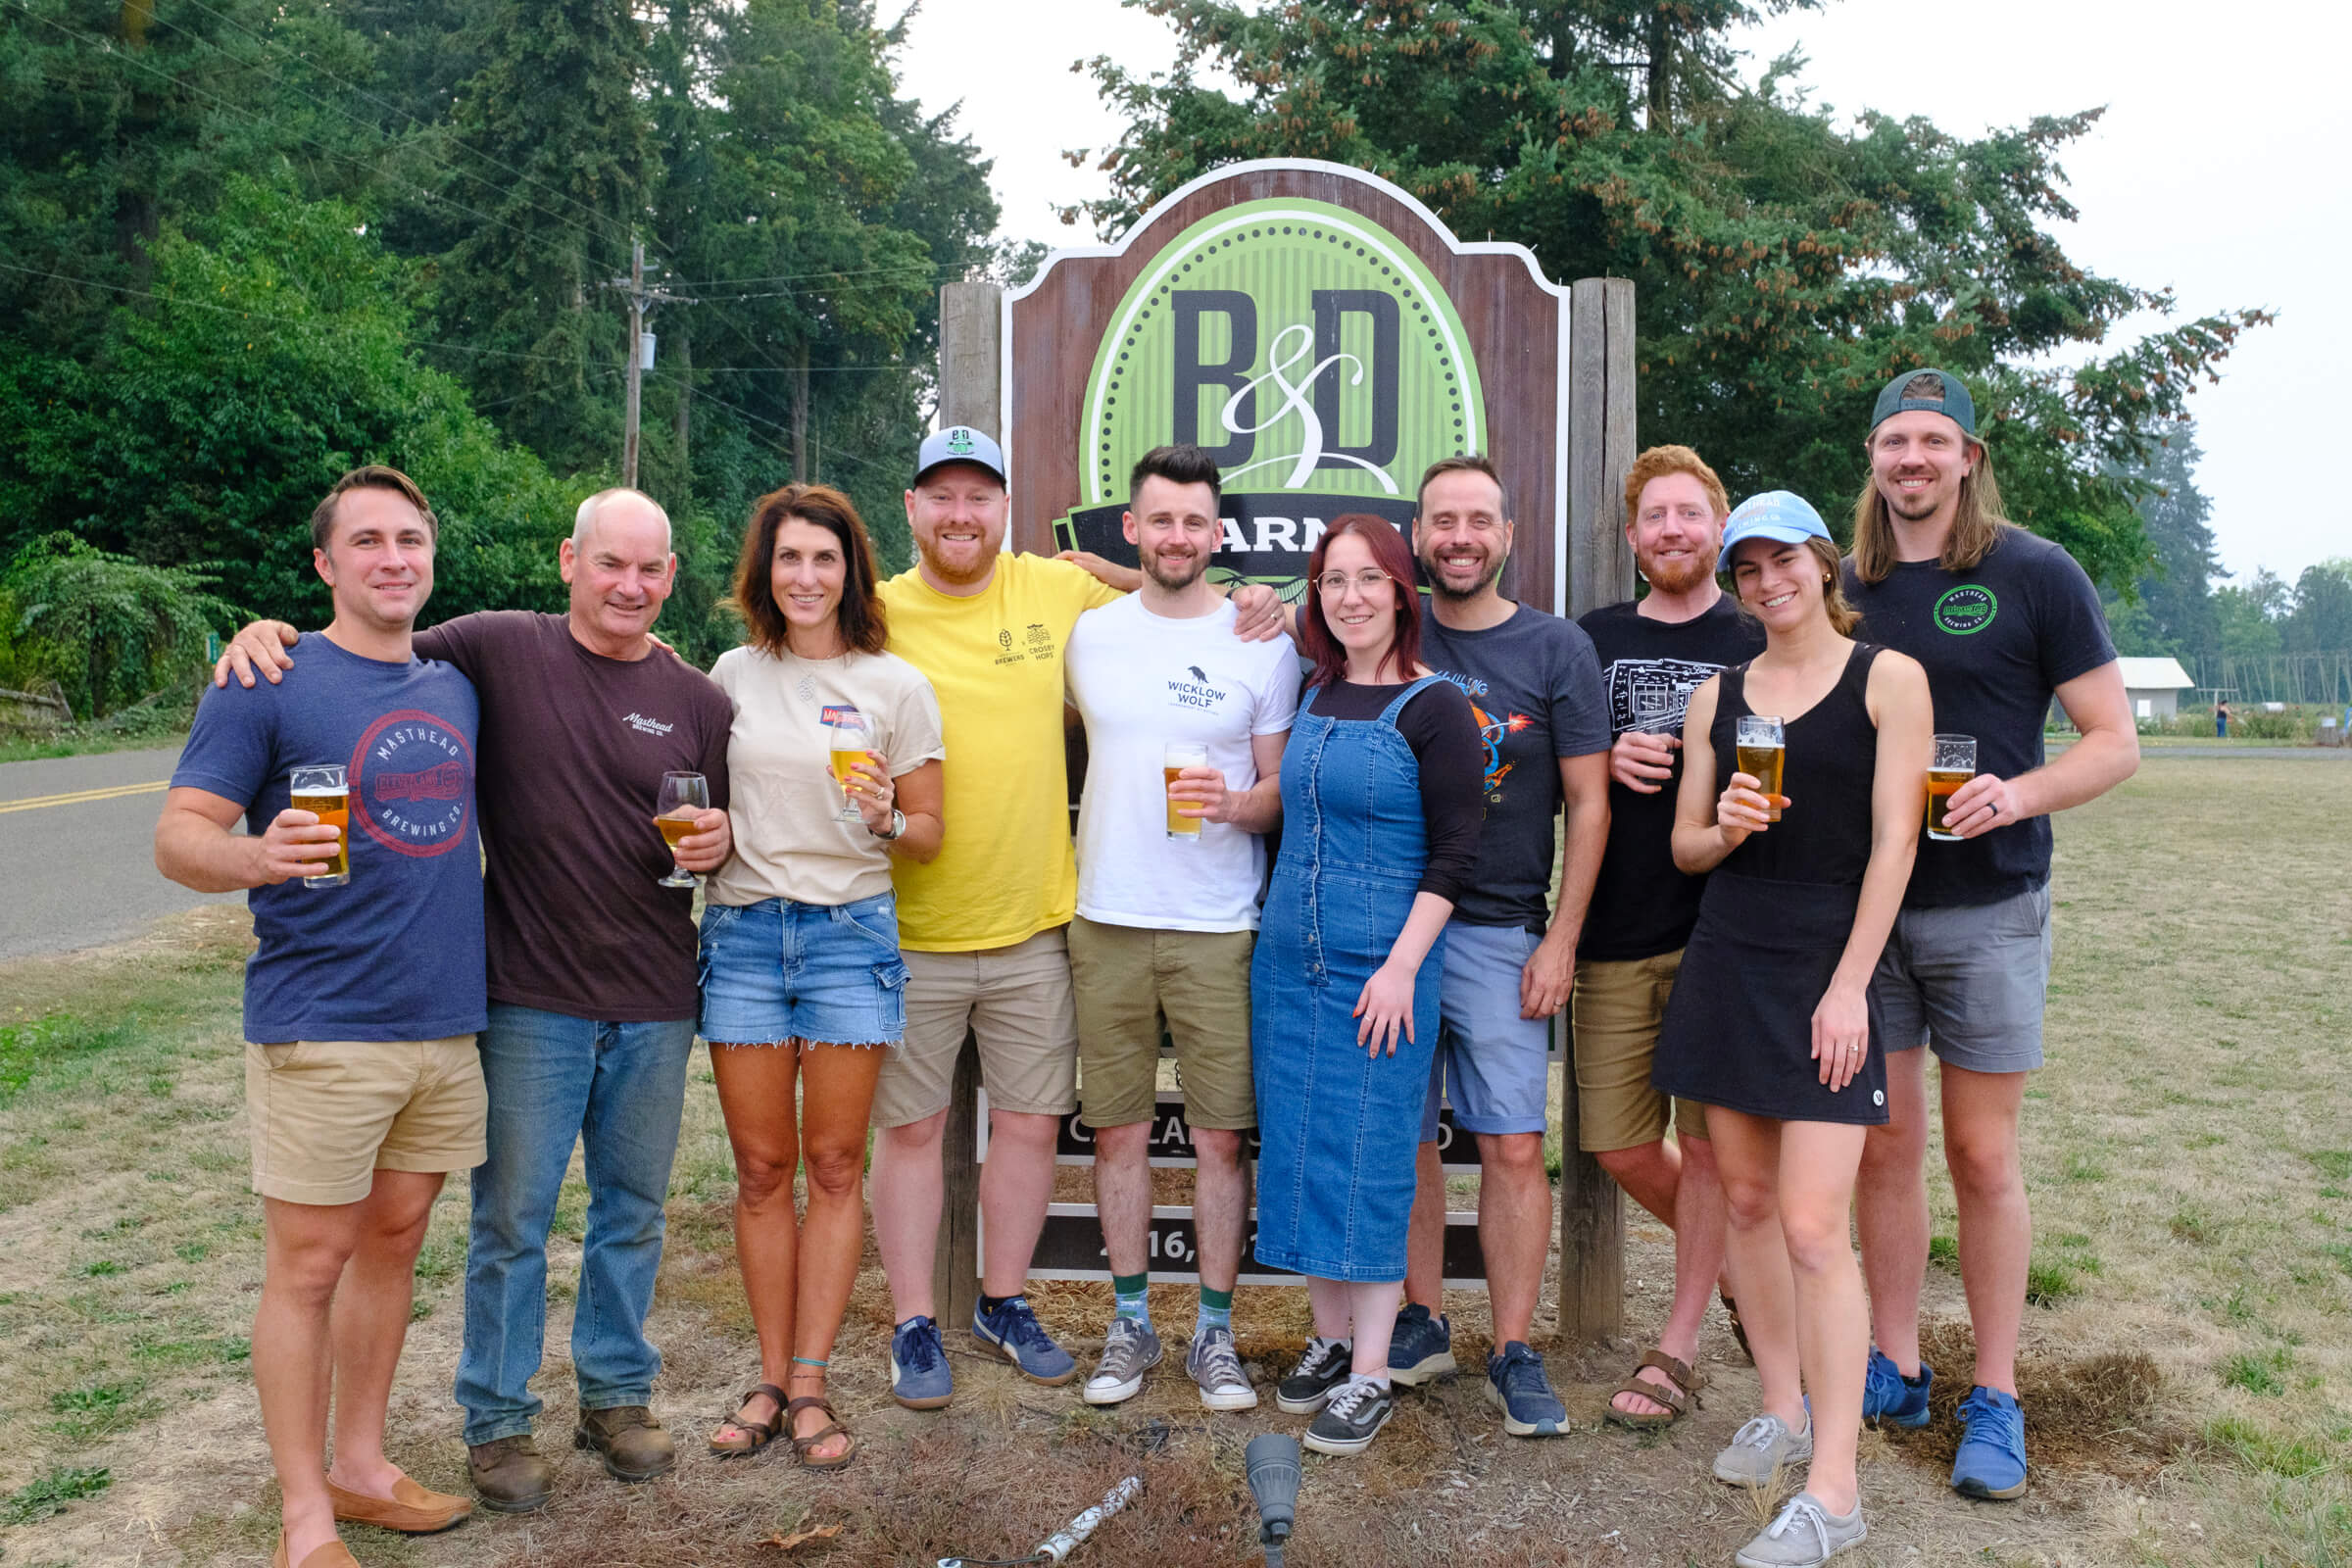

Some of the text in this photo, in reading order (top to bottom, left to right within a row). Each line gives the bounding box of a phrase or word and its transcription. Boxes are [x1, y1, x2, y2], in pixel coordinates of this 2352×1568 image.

[1171, 289, 1399, 488] B&D
[1168, 681, 1226, 701] WICKLOW
[1178, 694, 1212, 708] WOLF
[622, 713, 673, 732] Masthead
[377, 728, 459, 760] MASTHEAD
[382, 803, 463, 837] BREWING CO.
